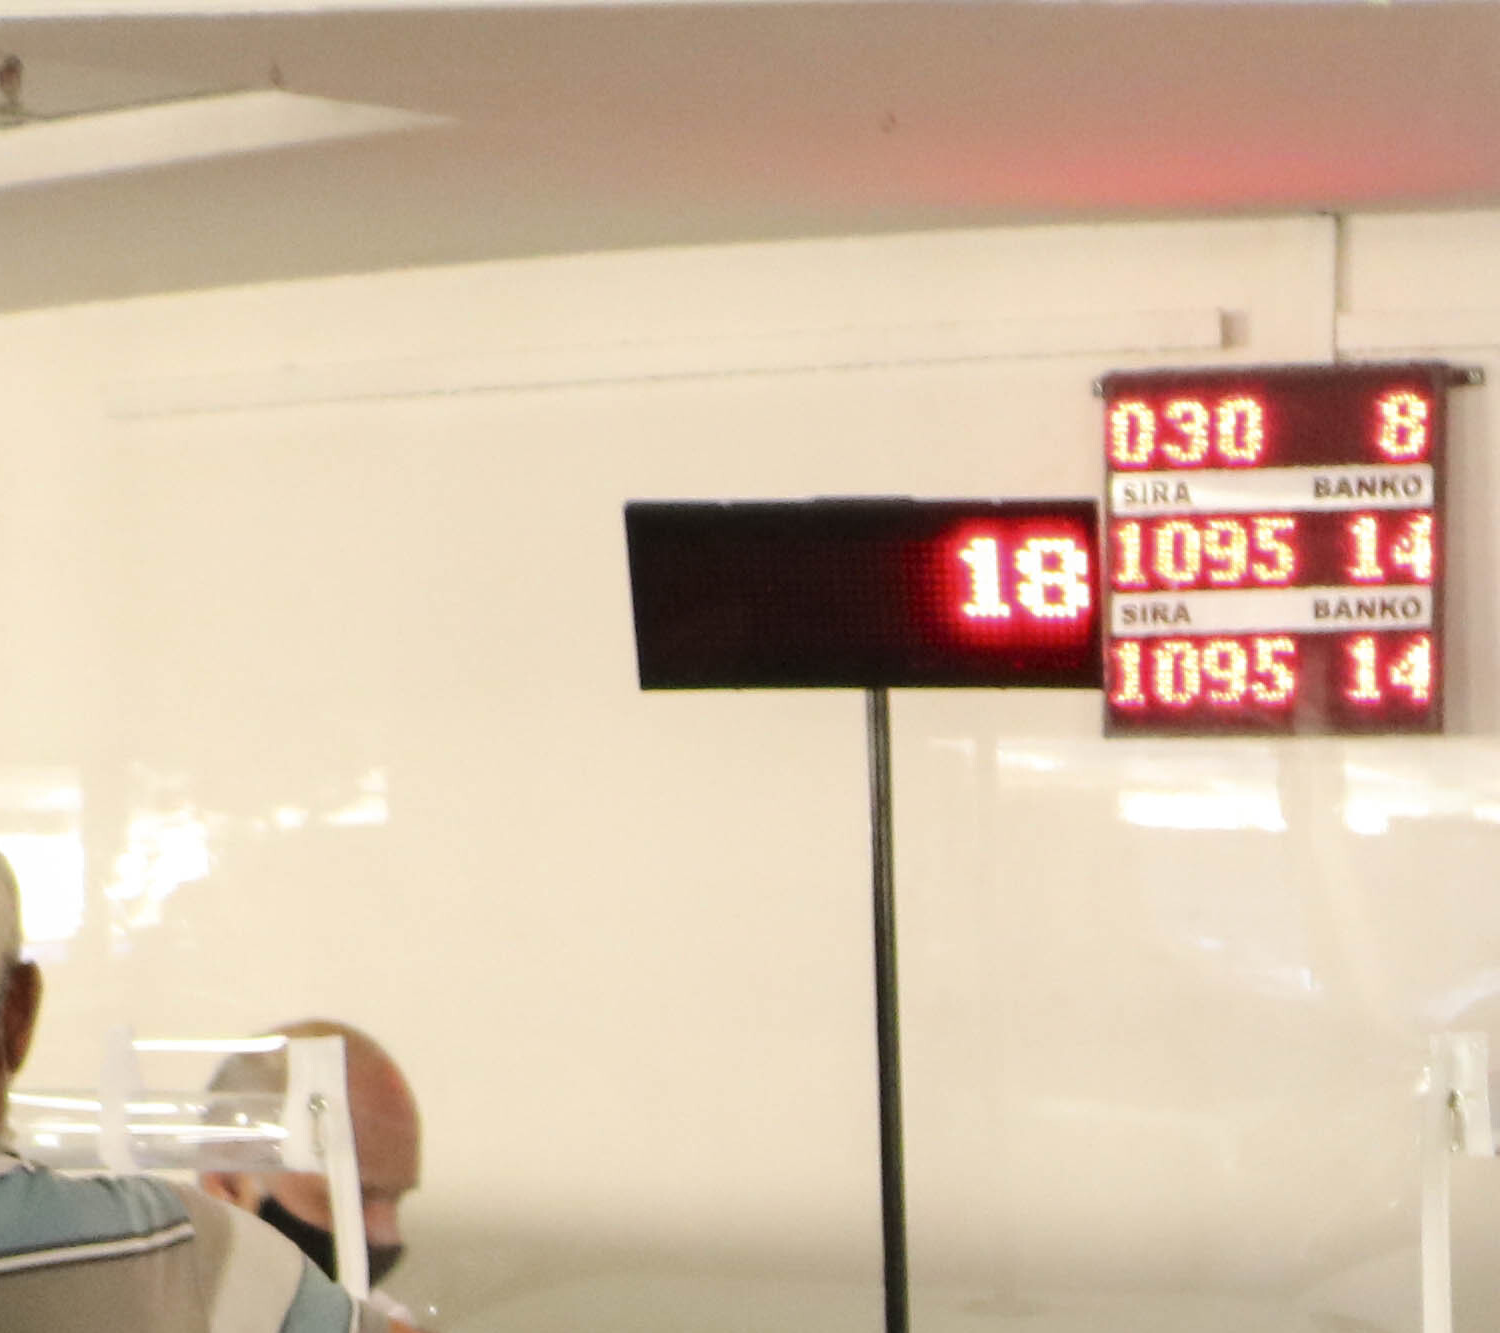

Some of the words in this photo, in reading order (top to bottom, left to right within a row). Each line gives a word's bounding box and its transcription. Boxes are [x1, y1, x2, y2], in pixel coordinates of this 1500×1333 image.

[1376, 392, 1429, 461] 8
[1123, 480, 1193, 505] SIRA
[1311, 474, 1424, 499] BANKO
[959, 536, 1091, 620] 18
[1112, 515, 1296, 586] 1095
[1348, 514, 1434, 583] 14
[1120, 602, 1193, 626] SIRA
[1311, 596, 1423, 622] BANKO
[1110, 636, 1296, 706] 1095
[1344, 635, 1433, 704] 14
